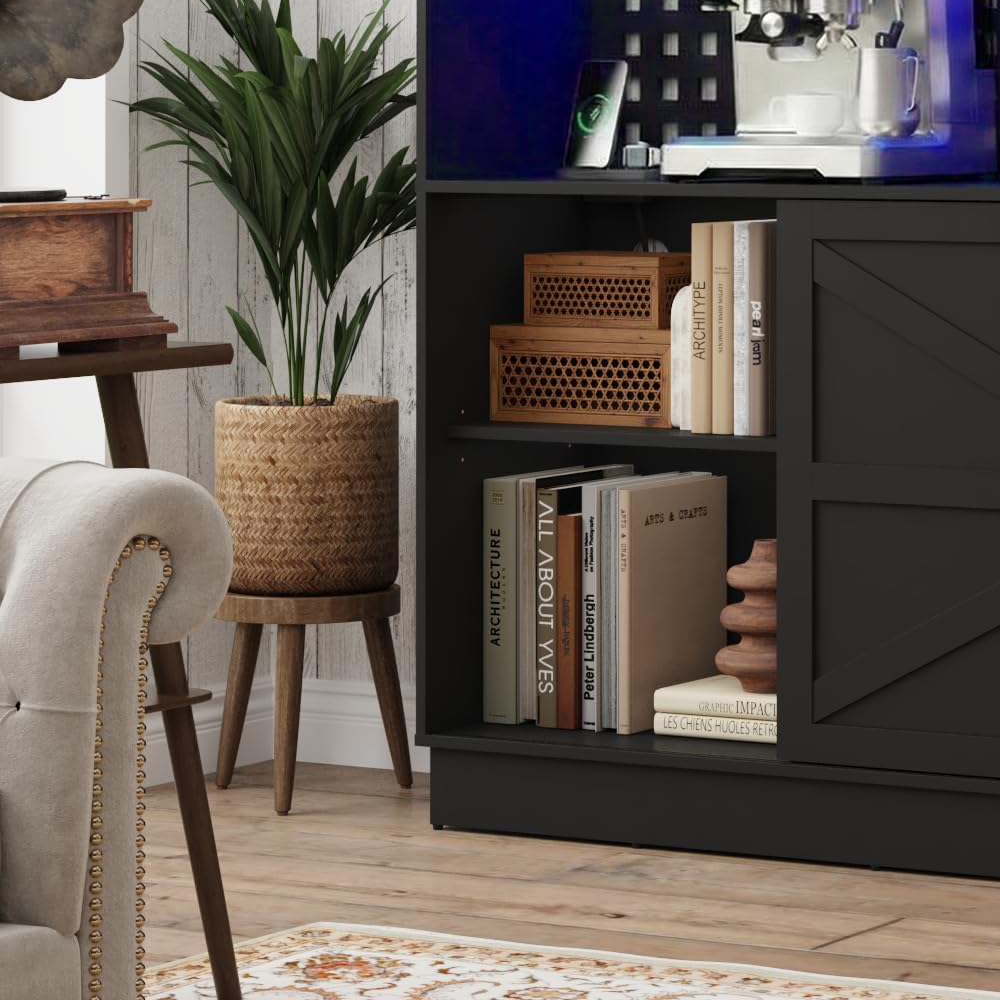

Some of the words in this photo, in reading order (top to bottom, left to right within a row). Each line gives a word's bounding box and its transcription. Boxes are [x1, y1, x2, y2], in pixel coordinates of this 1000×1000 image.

[692, 281, 706, 360] ARCHITYPE
[750, 301, 765, 337] pearl
[538, 500, 554, 541] ALL
[644, 513, 665, 526] ARTS
[679, 505, 708, 520] CRAFTS
[490, 528, 501, 647] ARCHITECTURE
[538, 549, 554, 629] ABOUT
[584, 593, 595, 662] Lindbergh
[538, 639, 554, 694] YVES
[584, 665, 595, 700] Peter
[663, 715, 678, 729] LES
[680, 716, 713, 732] CHIENS
[698, 701, 735, 713] GRAPHIC
[736, 700, 776, 717] IMPACT
